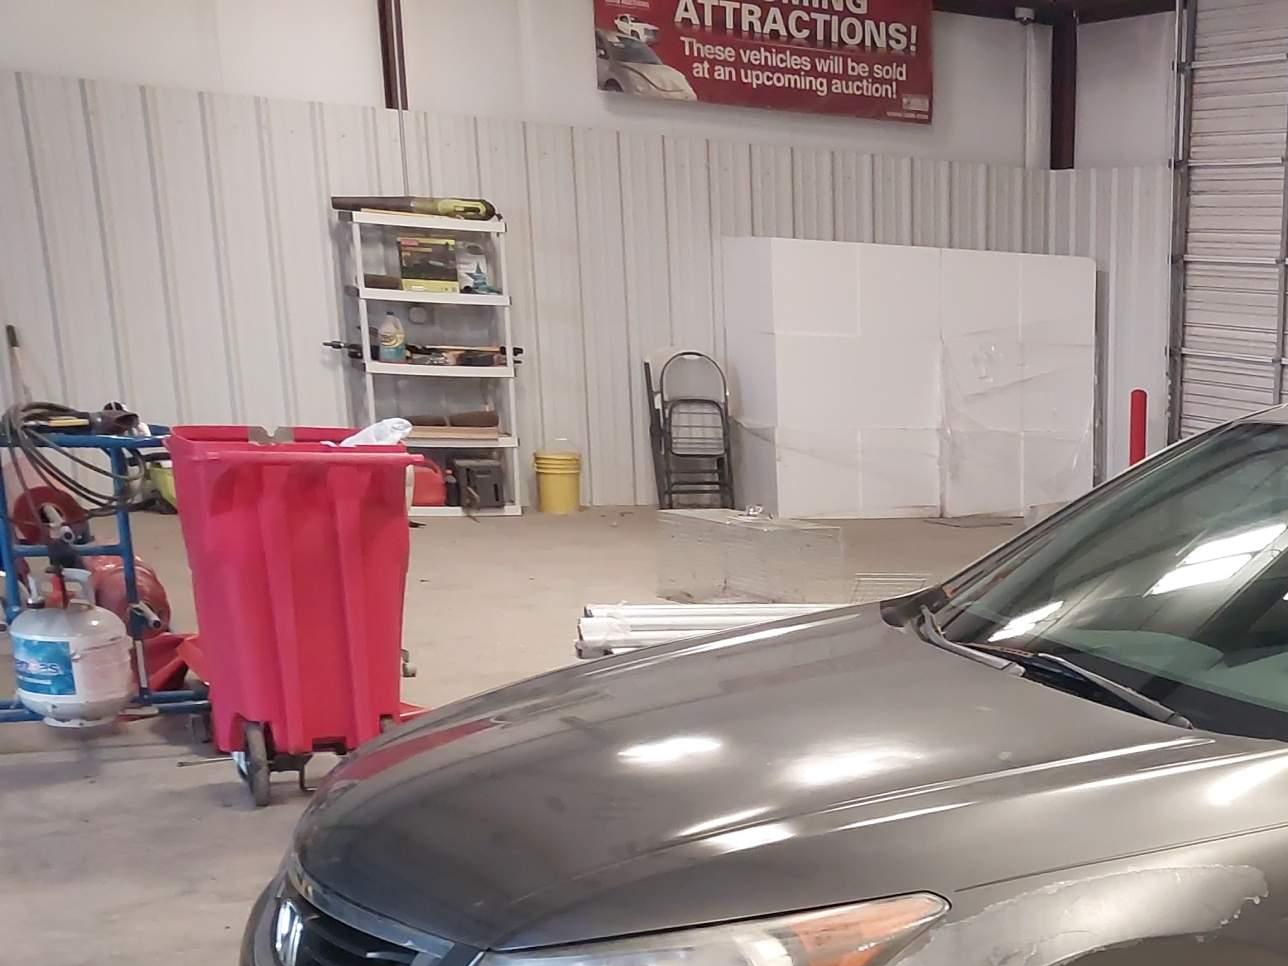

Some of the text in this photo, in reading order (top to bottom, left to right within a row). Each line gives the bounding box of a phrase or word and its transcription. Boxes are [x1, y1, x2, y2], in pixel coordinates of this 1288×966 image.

[674, 0, 917, 50] ATTRACTIONS!
[680, 36, 906, 80] These vehicles will be sold
[692, 60, 897, 98] at an upcoming auction!
